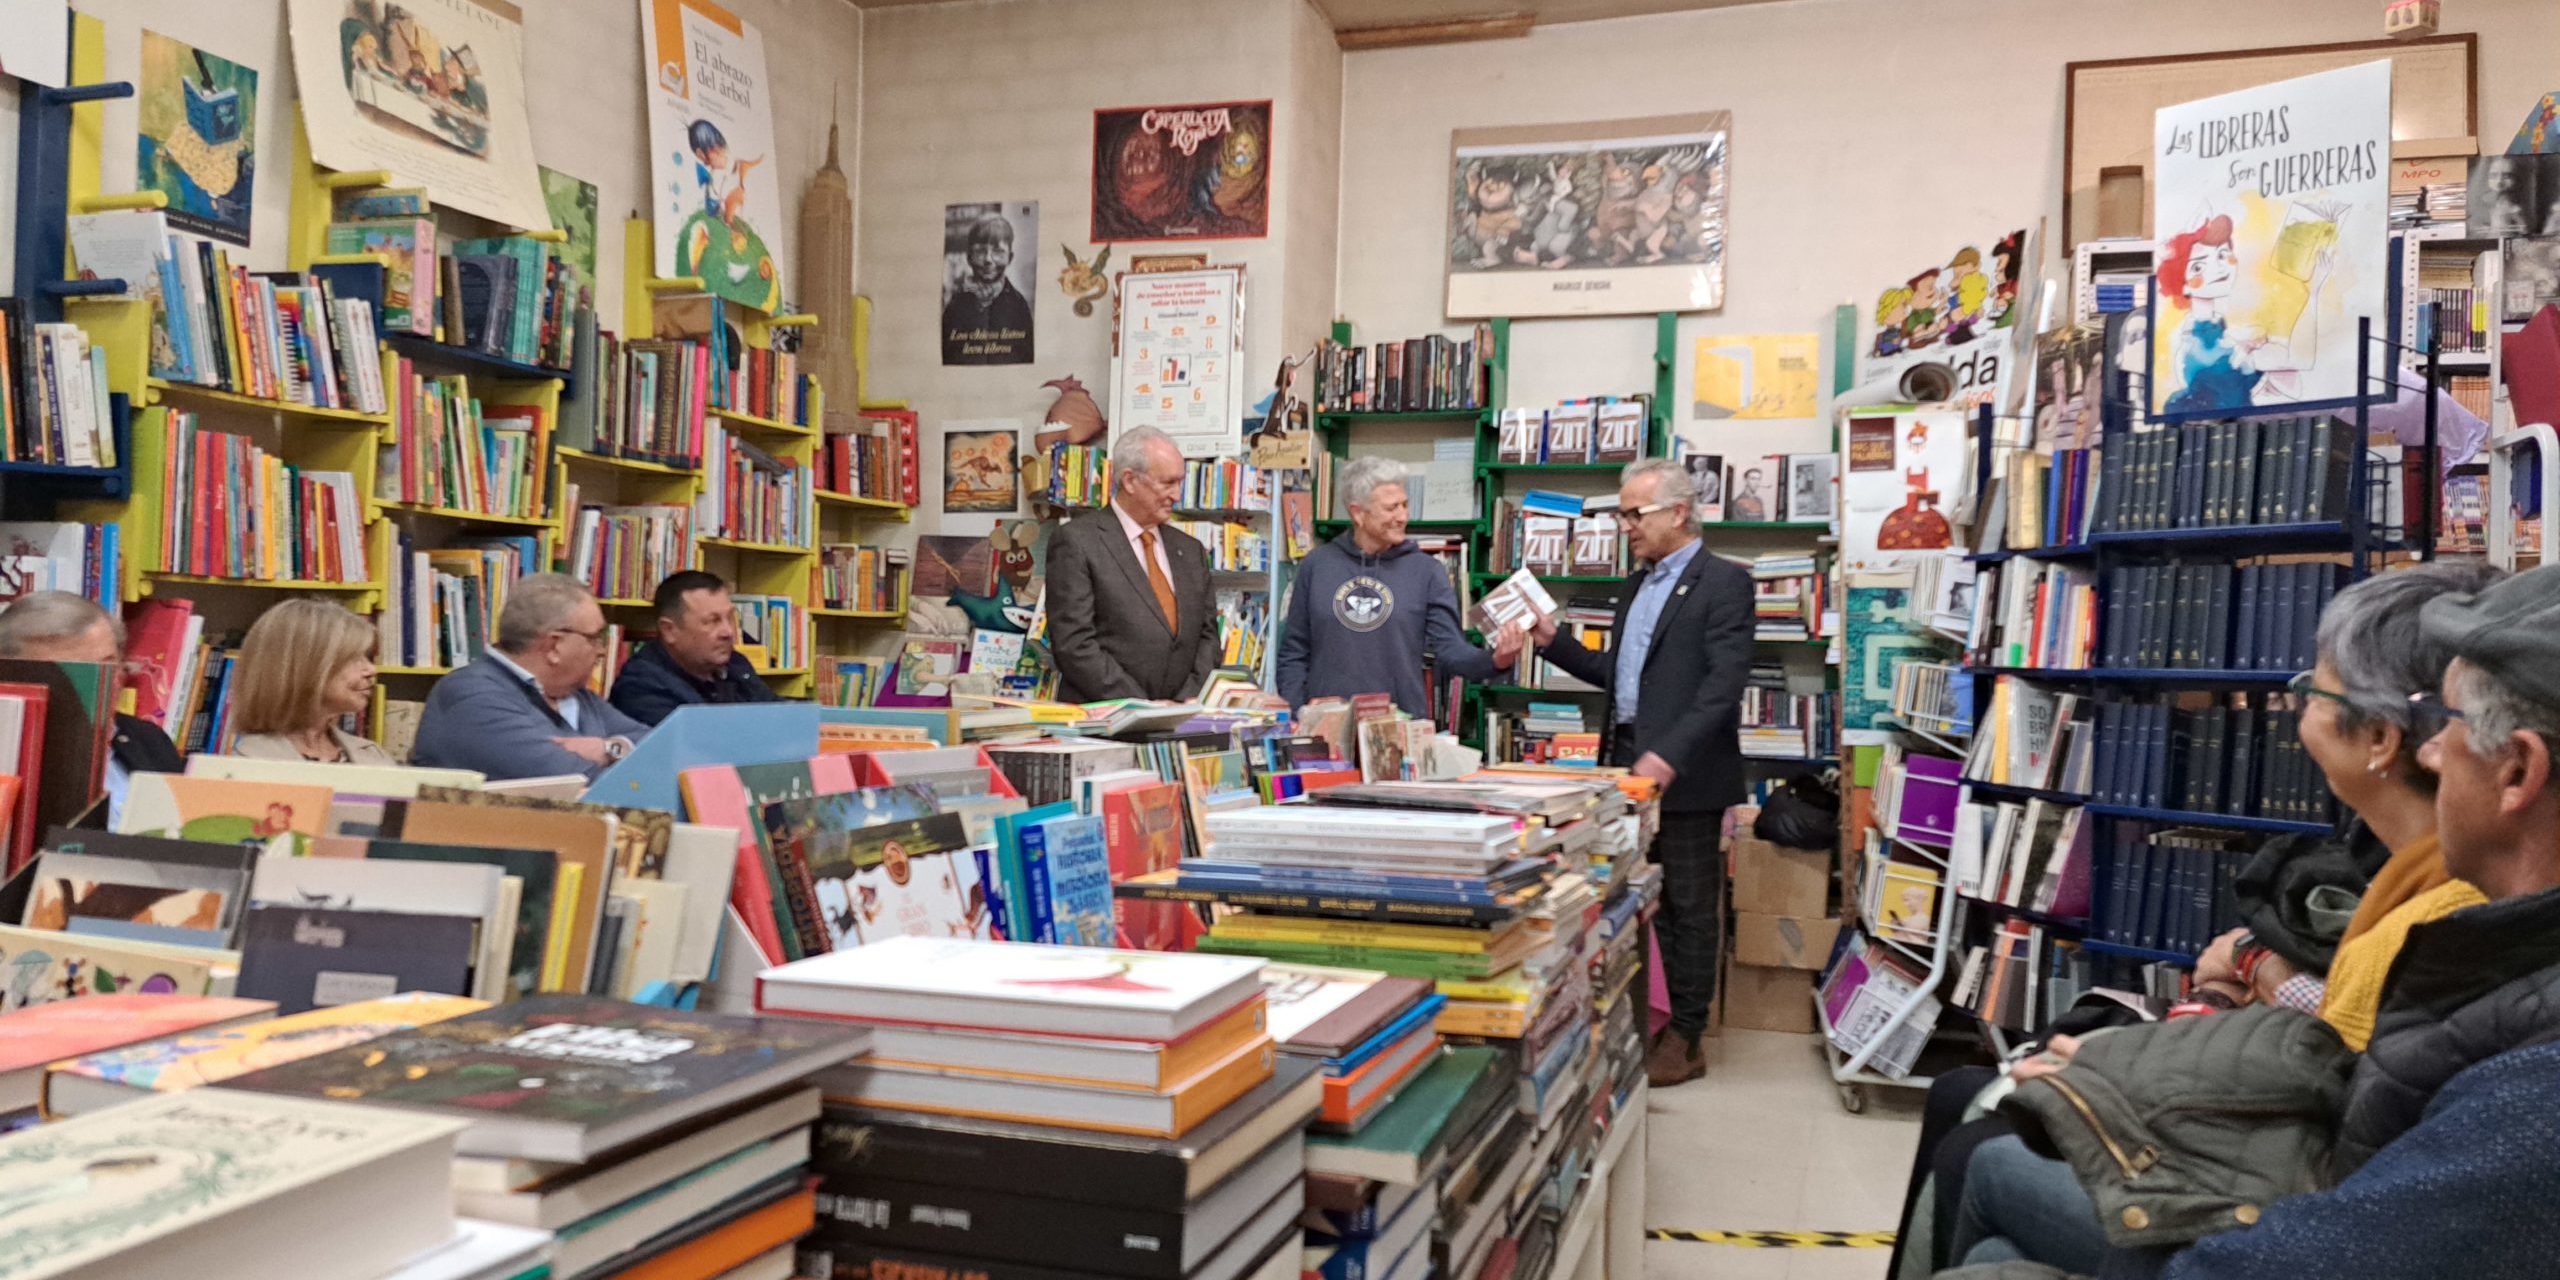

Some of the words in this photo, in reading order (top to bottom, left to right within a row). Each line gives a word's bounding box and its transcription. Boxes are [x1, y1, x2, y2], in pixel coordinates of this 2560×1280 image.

[694, 41, 708, 64] El
[711, 53, 753, 89] abrazo
[696, 65, 716, 91] del
[2165, 124, 2193, 155] Las
[2199, 105, 2291, 159] LIBRERAS
[2227, 159, 2257, 188] Son
[2258, 140, 2377, 198] GUERRERAS
[2401, 169, 2441, 179] MPO
